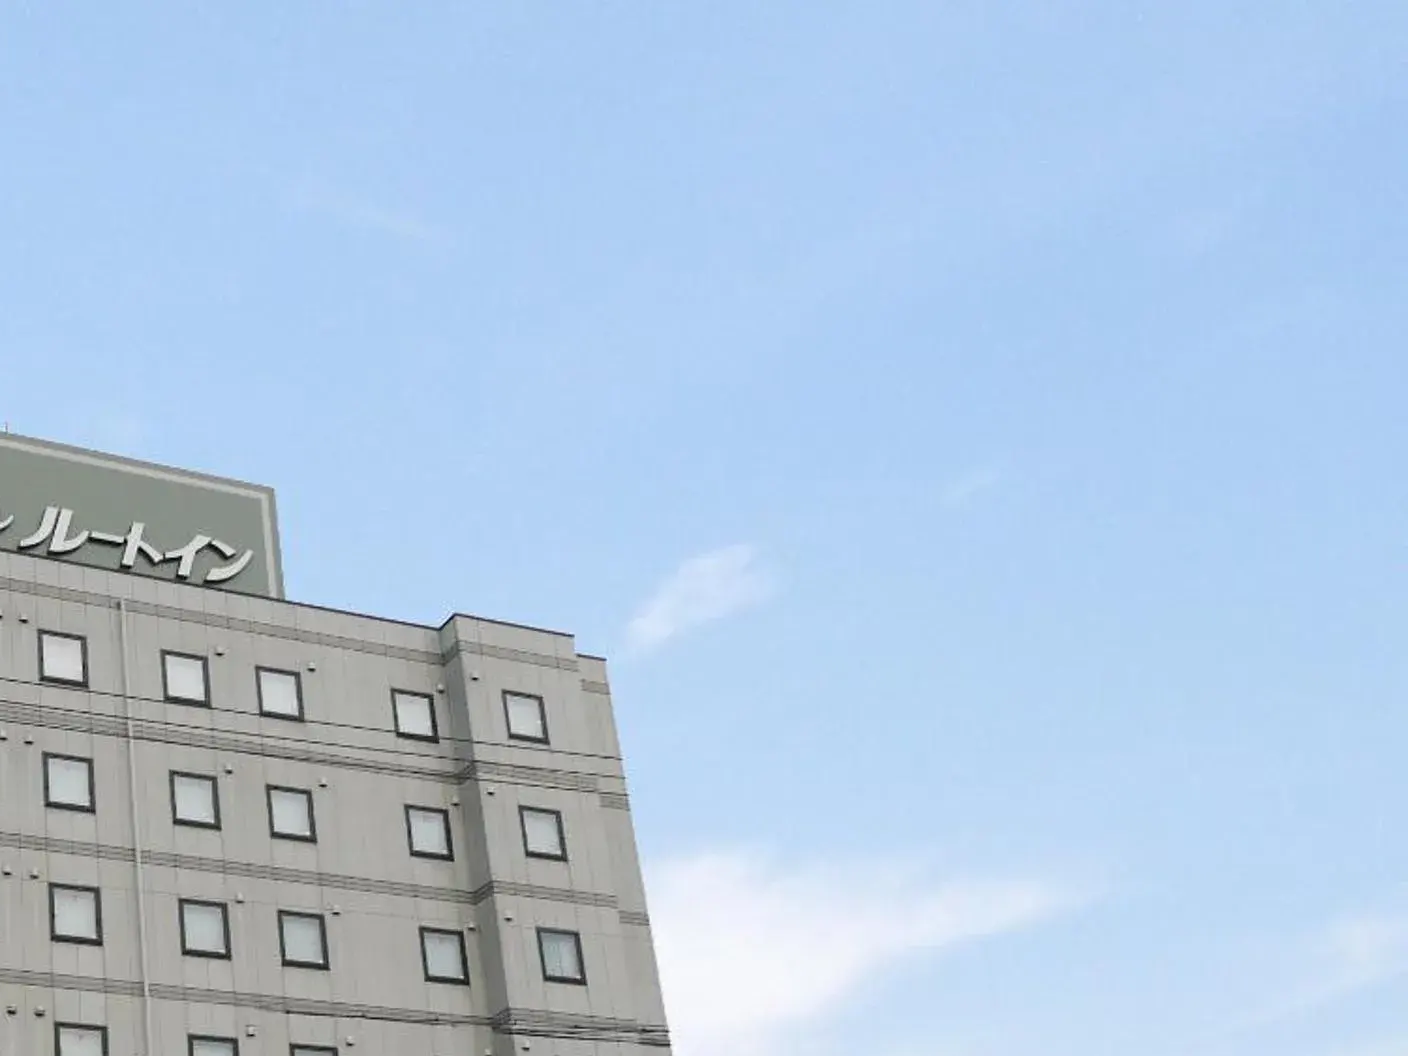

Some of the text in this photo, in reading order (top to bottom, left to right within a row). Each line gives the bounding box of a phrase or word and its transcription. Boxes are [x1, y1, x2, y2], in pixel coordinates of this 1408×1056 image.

[18, 505, 254, 582] ルートイン
